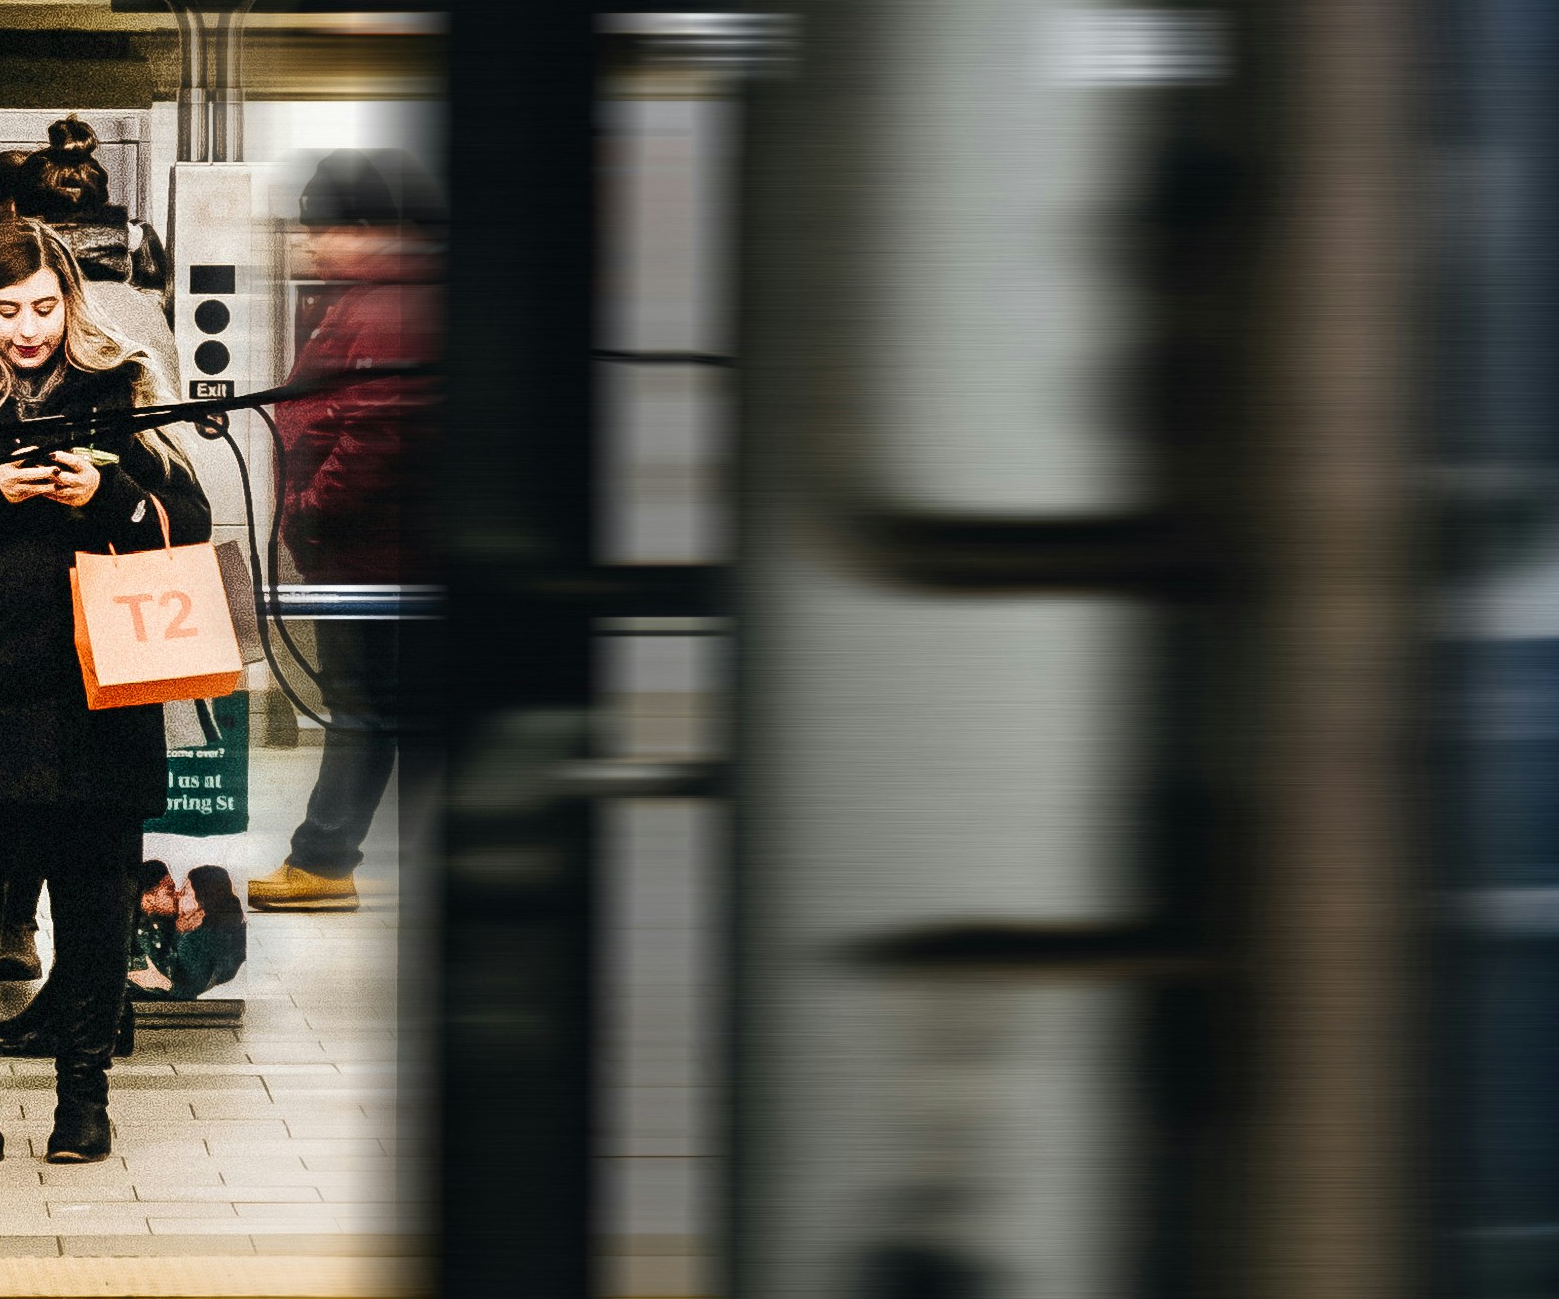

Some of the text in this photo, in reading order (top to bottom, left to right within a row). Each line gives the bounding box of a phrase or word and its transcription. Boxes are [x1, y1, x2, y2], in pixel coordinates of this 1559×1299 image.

[196, 382, 228, 398] Exit
[112, 590, 198, 643] T2
[178, 774, 200, 789] us
[204, 774, 222, 789] at
[216, 795, 236, 811] St
